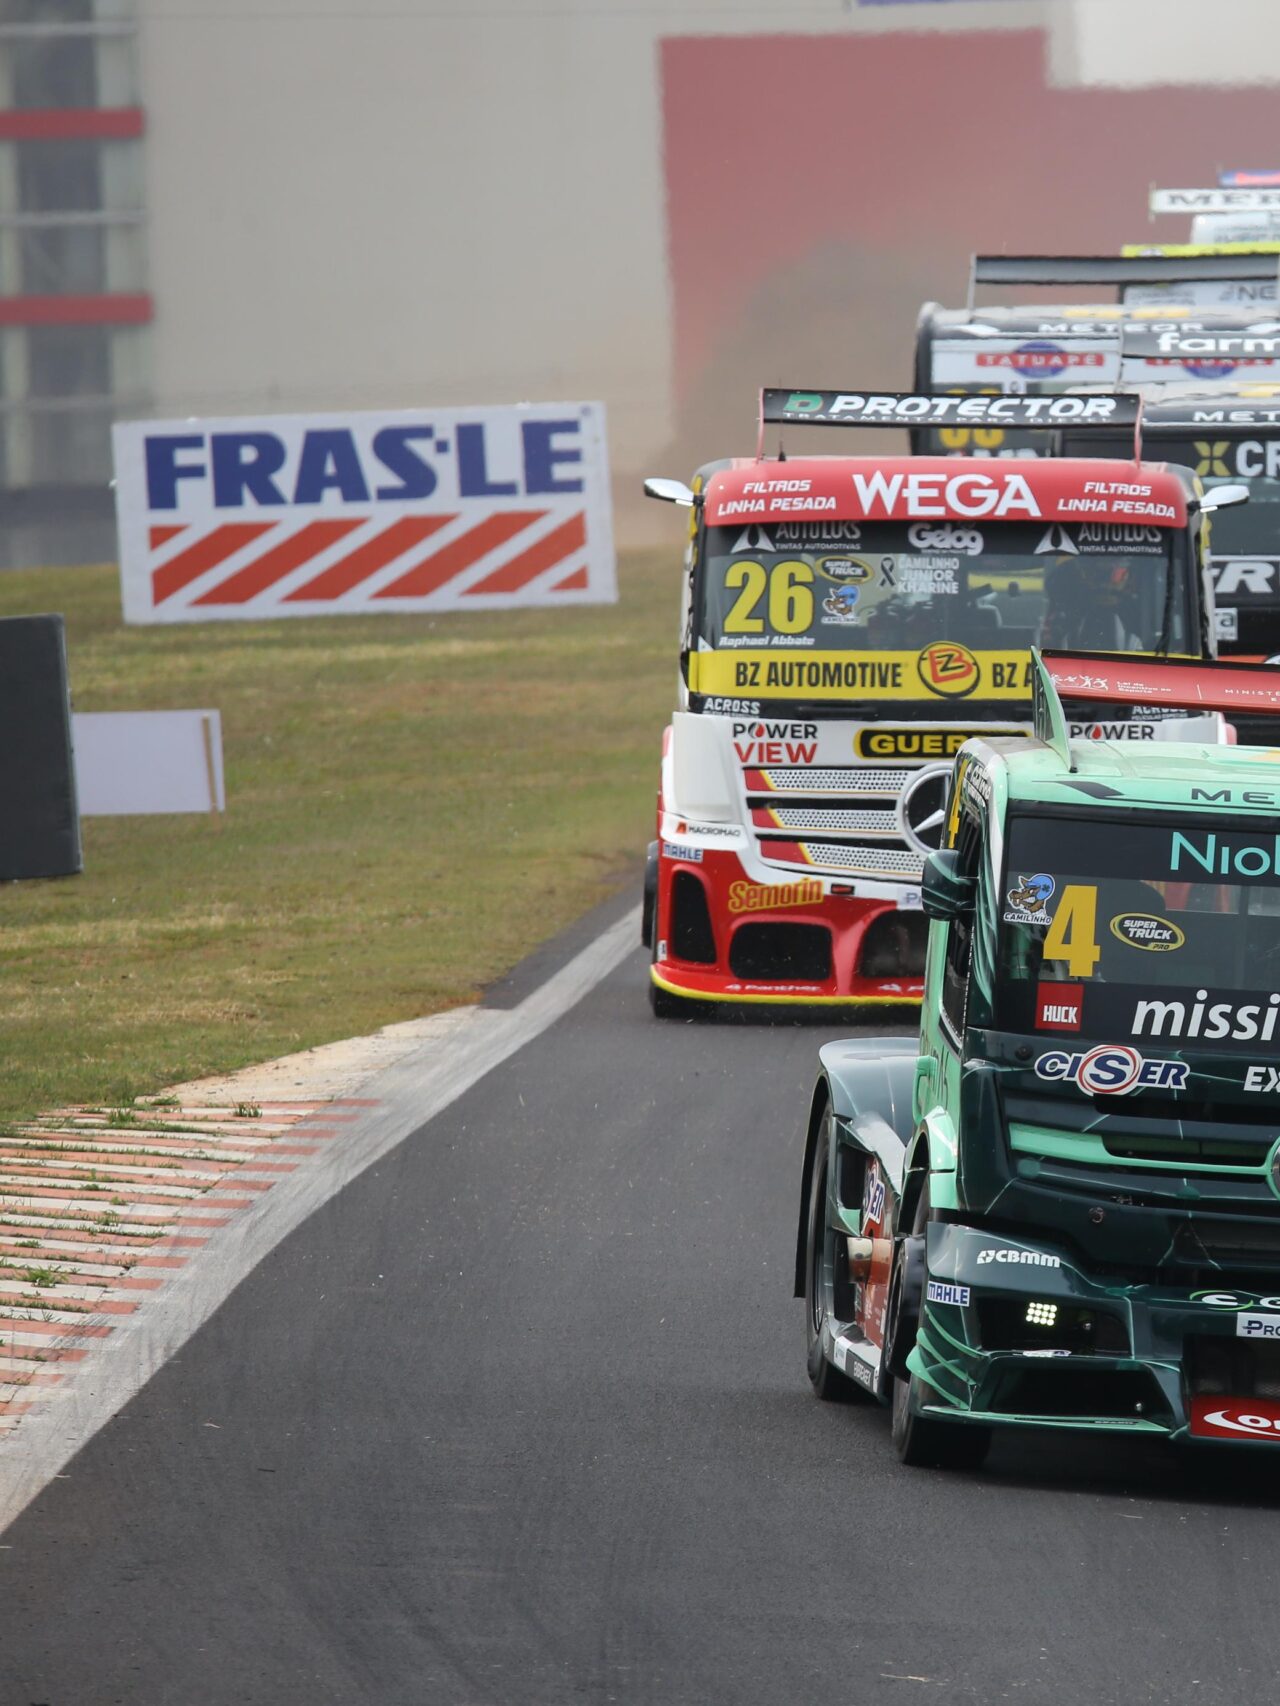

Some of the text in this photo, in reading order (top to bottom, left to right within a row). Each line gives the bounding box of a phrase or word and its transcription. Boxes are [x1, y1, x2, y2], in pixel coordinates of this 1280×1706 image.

[828, 395, 1117, 417] PROTECTOR
[743, 480, 812, 494] FILTROS
[852, 470, 1042, 517] WEGA
[1084, 481, 1152, 496] FILTROS
[717, 496, 836, 516] LINHA PESADA
[1057, 497, 1176, 518] LINHA PESADA
[775, 542, 861, 551] TINTAS AUTOMOTIVAS
[1079, 545, 1163, 554] TINTAS AUTOMOTIVAS
[829, 566, 864, 576] TRUCK
[900, 569, 954, 581] JUNIOR
[897, 581, 960, 594] KHARINE
[723, 560, 814, 634] 26
[719, 636, 815, 648] Raphael Abbate
[735, 661, 902, 688] BZ AUTOMOTIVE
[992, 662, 1017, 688] BZ
[703, 697, 760, 715] ACROSS
[733, 722, 818, 739] POWER
[1070, 724, 1154, 740] POWER
[869, 734, 968, 753] GUER
[733, 742, 818, 764] VIEW
[728, 877, 824, 913] Semorin
[1004, 912, 1052, 925] CAMILINHO
[1123, 919, 1157, 929] SUPER
[1043, 884, 1101, 977] 4
[1128, 927, 1173, 940] TRUCK
[1152, 943, 1171, 951] PRO
[1042, 1005, 1078, 1024] HUCK
[1036, 1048, 1189, 1092] CISER
[928, 1283, 969, 1305] MAHLE
